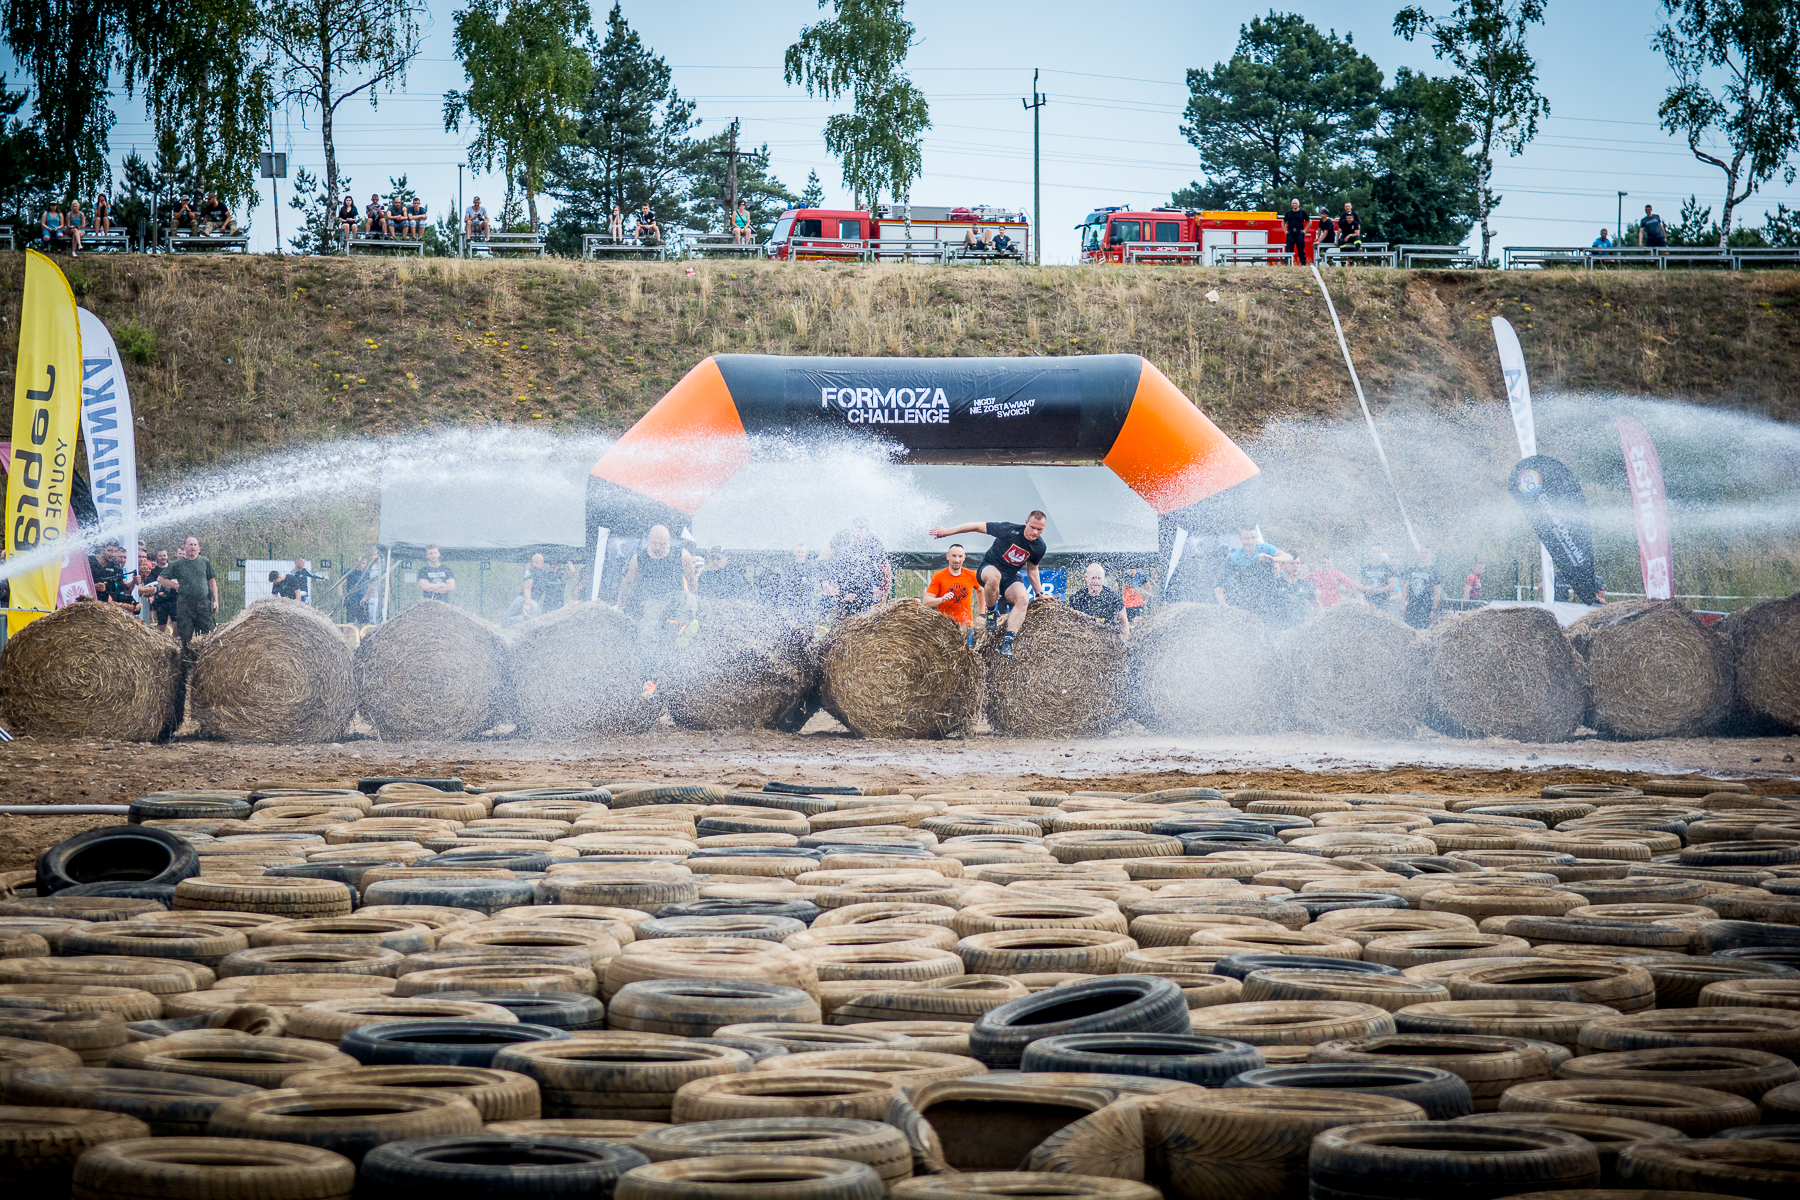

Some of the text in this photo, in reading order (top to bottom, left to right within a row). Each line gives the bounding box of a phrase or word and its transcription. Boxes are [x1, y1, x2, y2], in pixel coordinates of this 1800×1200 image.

[821, 387, 949, 409] FORMOZA
[973, 397, 995, 407] NIGDY
[969, 399, 1036, 415] NIE ZOSTAWIAMY
[997, 407, 1030, 418] SWOICH
[848, 408, 949, 424] CHALLENGE
[1523, 474, 1537, 492] GO
[1558, 523, 1585, 564] Oborniki
